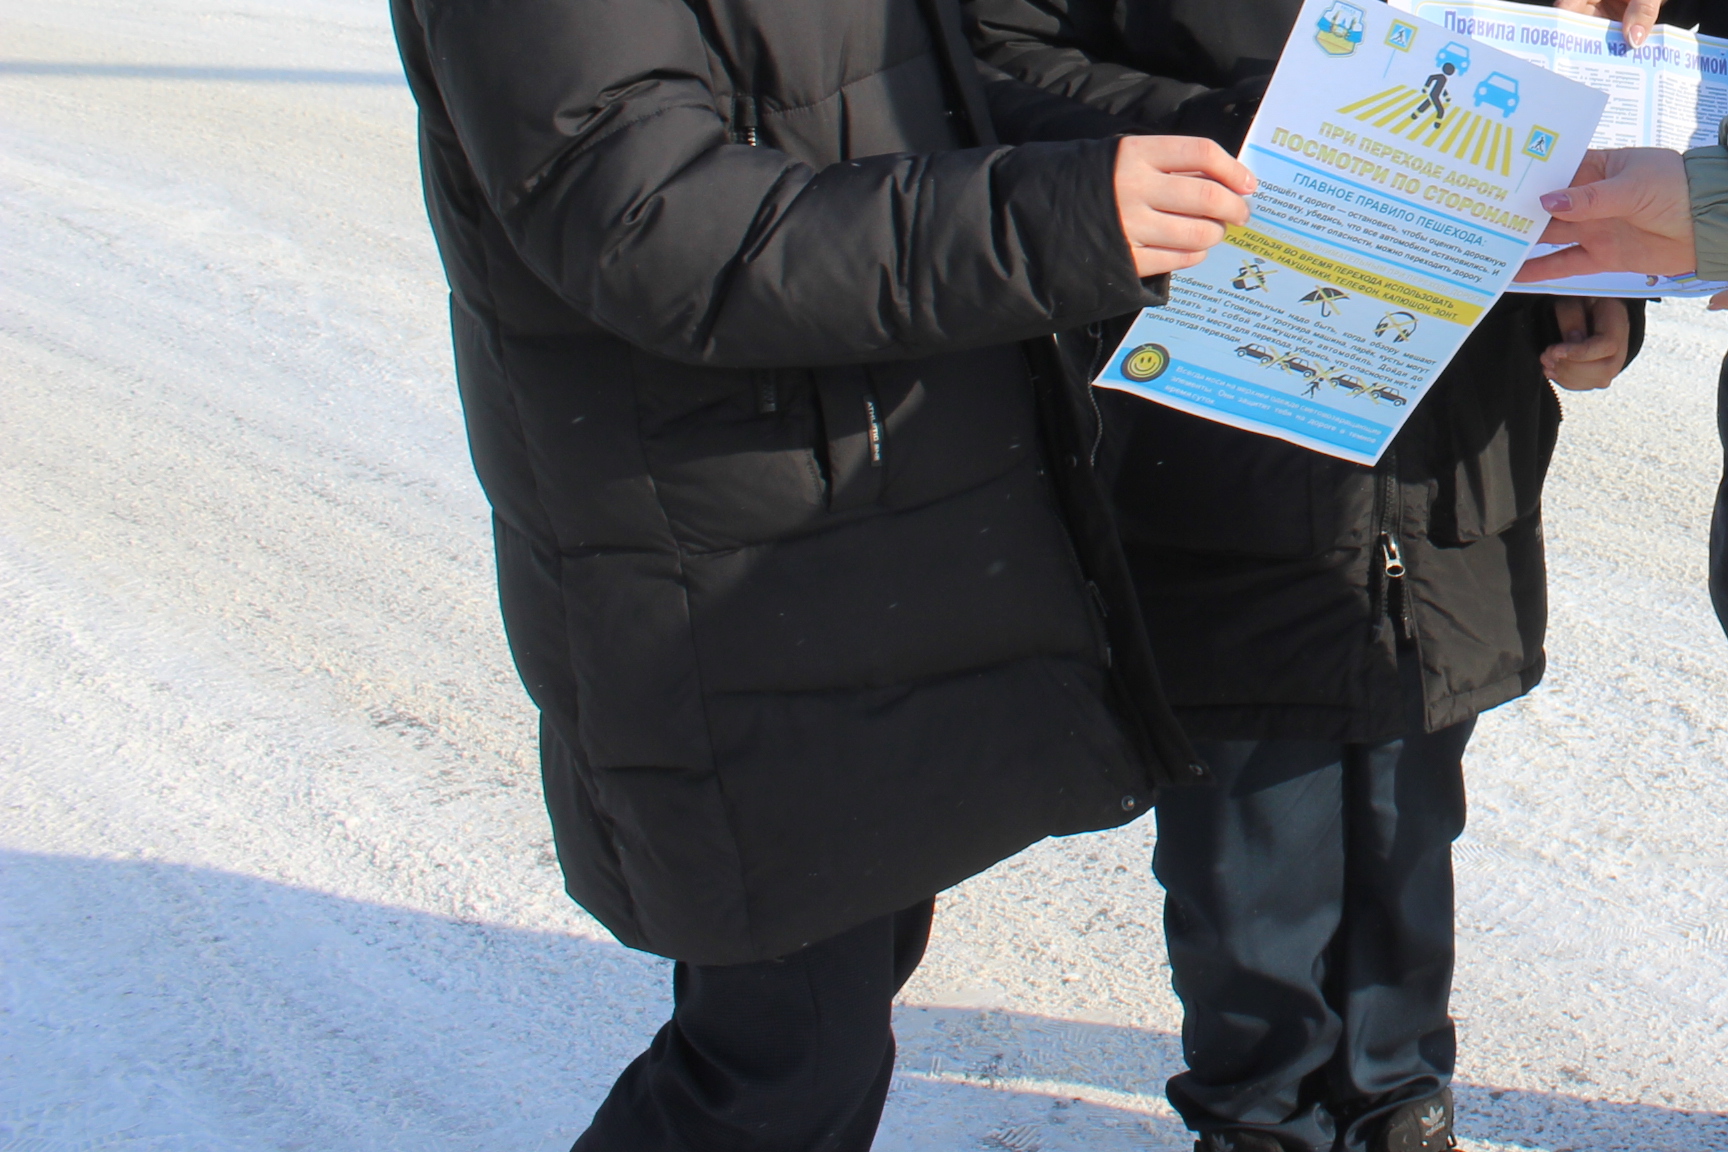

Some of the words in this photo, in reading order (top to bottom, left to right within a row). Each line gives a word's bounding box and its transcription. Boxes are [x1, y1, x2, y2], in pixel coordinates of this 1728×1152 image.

[1443, 10, 1515, 45] Правила
[1520, 24, 1603, 56] поведения
[1607, 39, 1636, 57] на
[1632, 42, 1681, 66] дороге
[1684, 51, 1728, 76] зимой
[1272, 127, 1391, 184] ПОСМОТРИ
[1391, 172, 1422, 194] ПО
[1423, 184, 1535, 233] СТОРОНАМ!
[1292, 172, 1356, 203] ГЛАВНОЕ
[1354, 194, 1416, 223] ПРАВИЛО
[1415, 215, 1487, 247] ПЕШЕХОДА:
[1240, 231, 1284, 251] НЕЛЬЗЯ
[1282, 247, 1299, 257] ВО
[1298, 253, 1334, 270] ВРЕМЯ
[1333, 265, 1383, 287] ПЕРЕХОДА
[1383, 281, 1455, 309] ИСПОЛЬЗОВАТЬ
[1251, 191, 1304, 214] обстановку,
[1304, 209, 1344, 228] убедись,
[1346, 222, 1362, 232] что
[1362, 227, 1379, 238] все
[1378, 233, 1431, 254] автомобили
[1430, 250, 1490, 274] остановились.
[1255, 204, 1288, 219] только
[1287, 215, 1310, 227] если
[1310, 223, 1327, 232] нет
[1326, 228, 1373, 249] опасности,
[1375, 243, 1404, 257] можно
[1403, 253, 1452, 273] переходить
[1451, 268, 1483, 284] дорогу.
[1302, 196, 1337, 212] дороге
[1347, 211, 1399, 234] остановись,
[1401, 228, 1429, 242] чтобы
[1428, 238, 1463, 254] оценить
[1462, 249, 1507, 268] дорожную
[1276, 254, 1332, 282] НАУШНИКИ,
[1335, 275, 1380, 297] ТЕЛЕФОН,
[1381, 292, 1432, 314] КАПЮШОН,
[1432, 307, 1459, 320] ЗОНТ.
[1145, 312, 1176, 324] только
[1175, 319, 1200, 331] тогда
[1198, 326, 1241, 343] переходи.
[1167, 285, 1223, 305] репятствия!
[1223, 299, 1263, 318] Стоящие
[1272, 317, 1312, 335] тротуара
[1378, 354, 1405, 367] кусты
[1405, 363, 1431, 374] могут
[1205, 317, 1233, 330] места
[1231, 326, 1251, 335] для
[1250, 331, 1293, 350] перехода,
[1334, 359, 1349, 368] что
[1349, 364, 1394, 383] опасности
[1206, 306, 1218, 315] за
[1221, 311, 1251, 325] собой
[1252, 322, 1314, 346] движущийся
[1377, 363, 1409, 378] Дойди
[1409, 374, 1424, 382] до
[1216, 287, 1285, 315] внимательным
[1287, 313, 1311, 325] надо
[1342, 331, 1367, 344] когда
[1369, 341, 1400, 356] обзору
[1402, 352, 1437, 366] мешают
